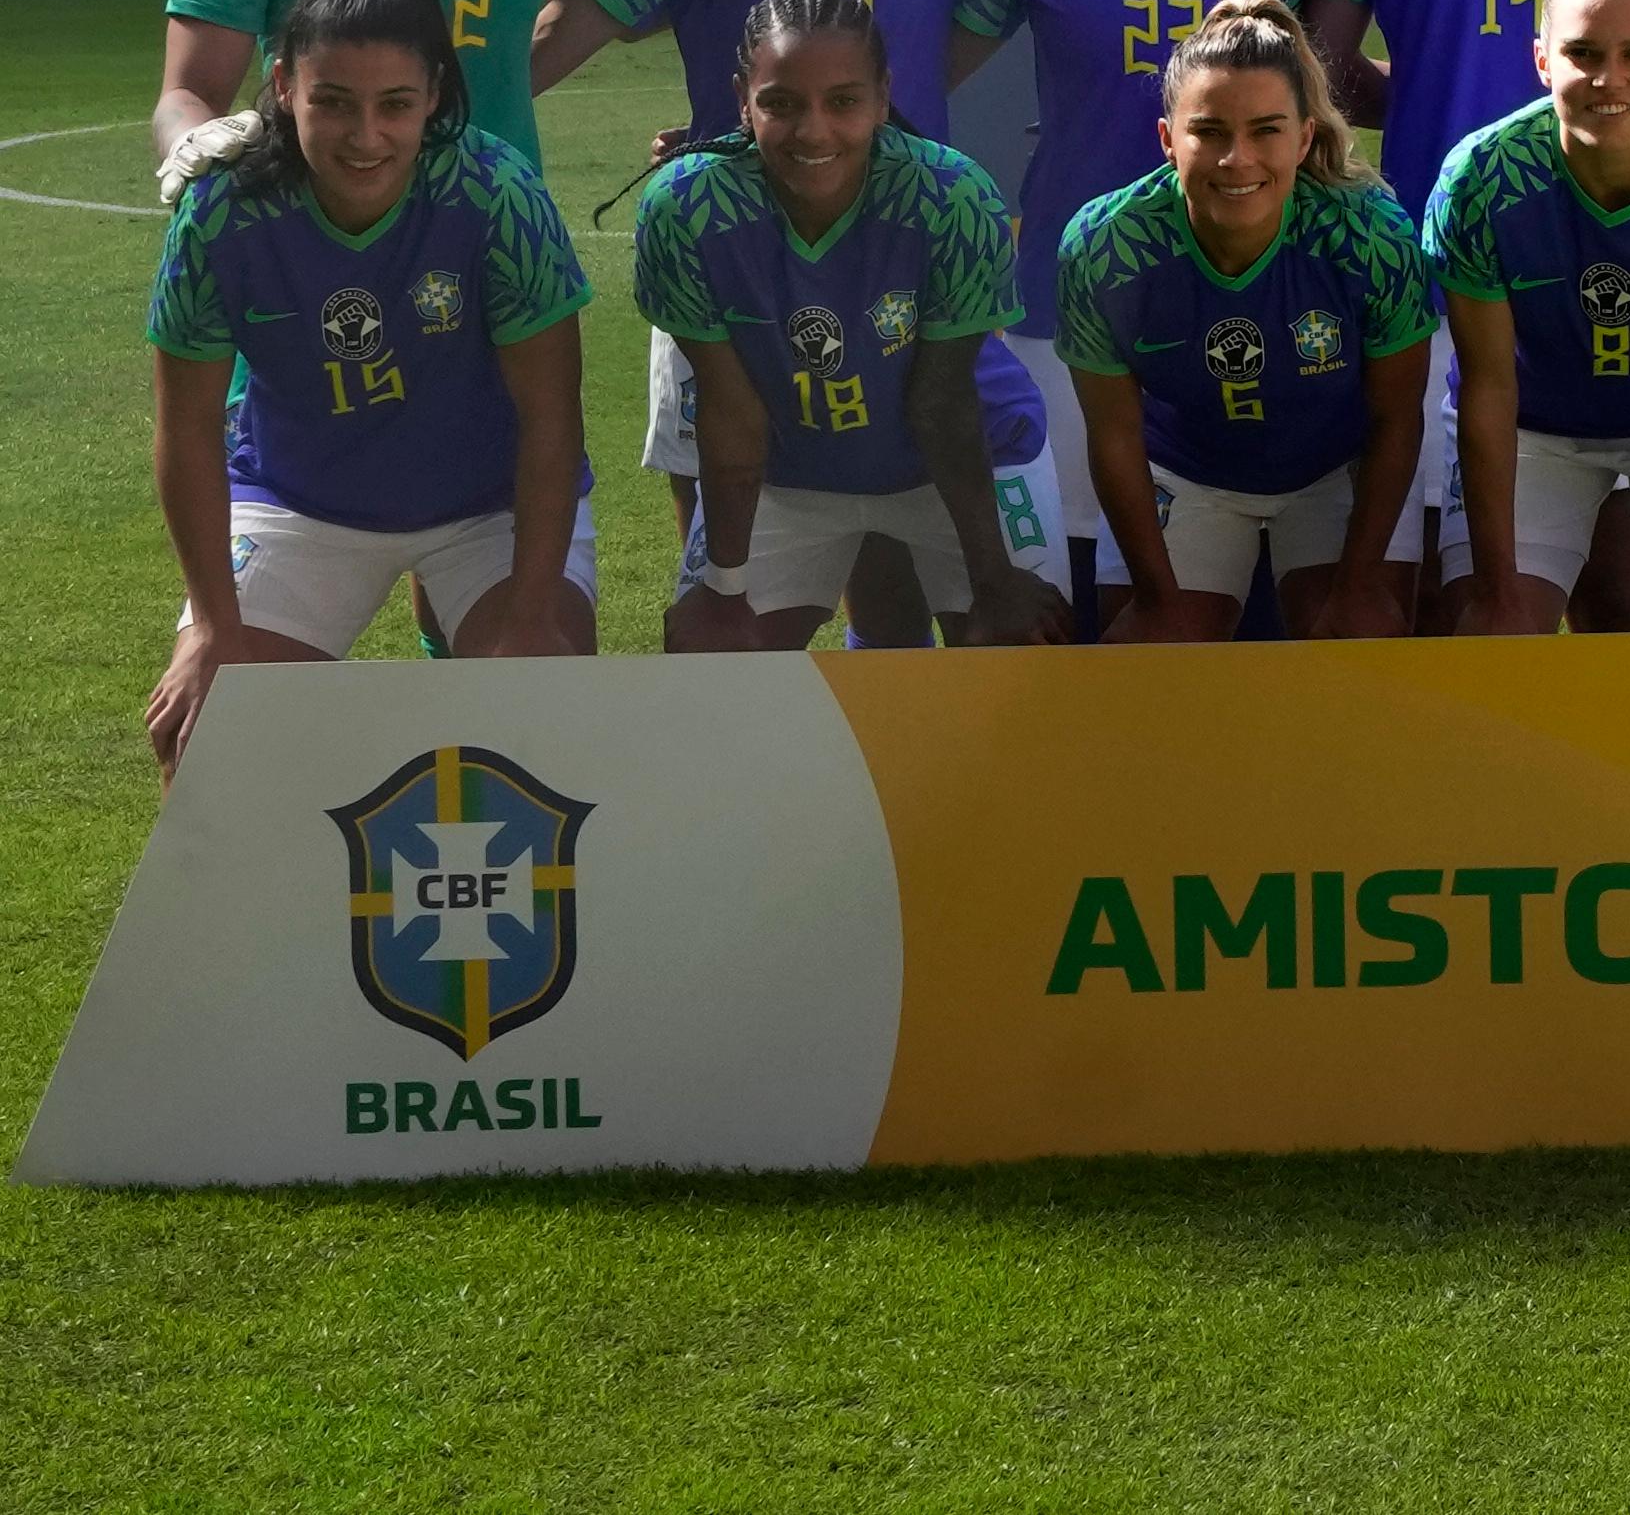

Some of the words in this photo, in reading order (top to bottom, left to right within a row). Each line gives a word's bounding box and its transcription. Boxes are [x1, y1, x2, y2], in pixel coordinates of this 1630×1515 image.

[1299, 360, 1348, 377] BRASIL
[1592, 325, 1630, 377] 8
[324, 348, 405, 415] 15
[793, 371, 870, 433] 18
[1221, 379, 1264, 422] 6
[417, 873, 508, 909] CBF
[346, 1078, 602, 1134] BRASIL
